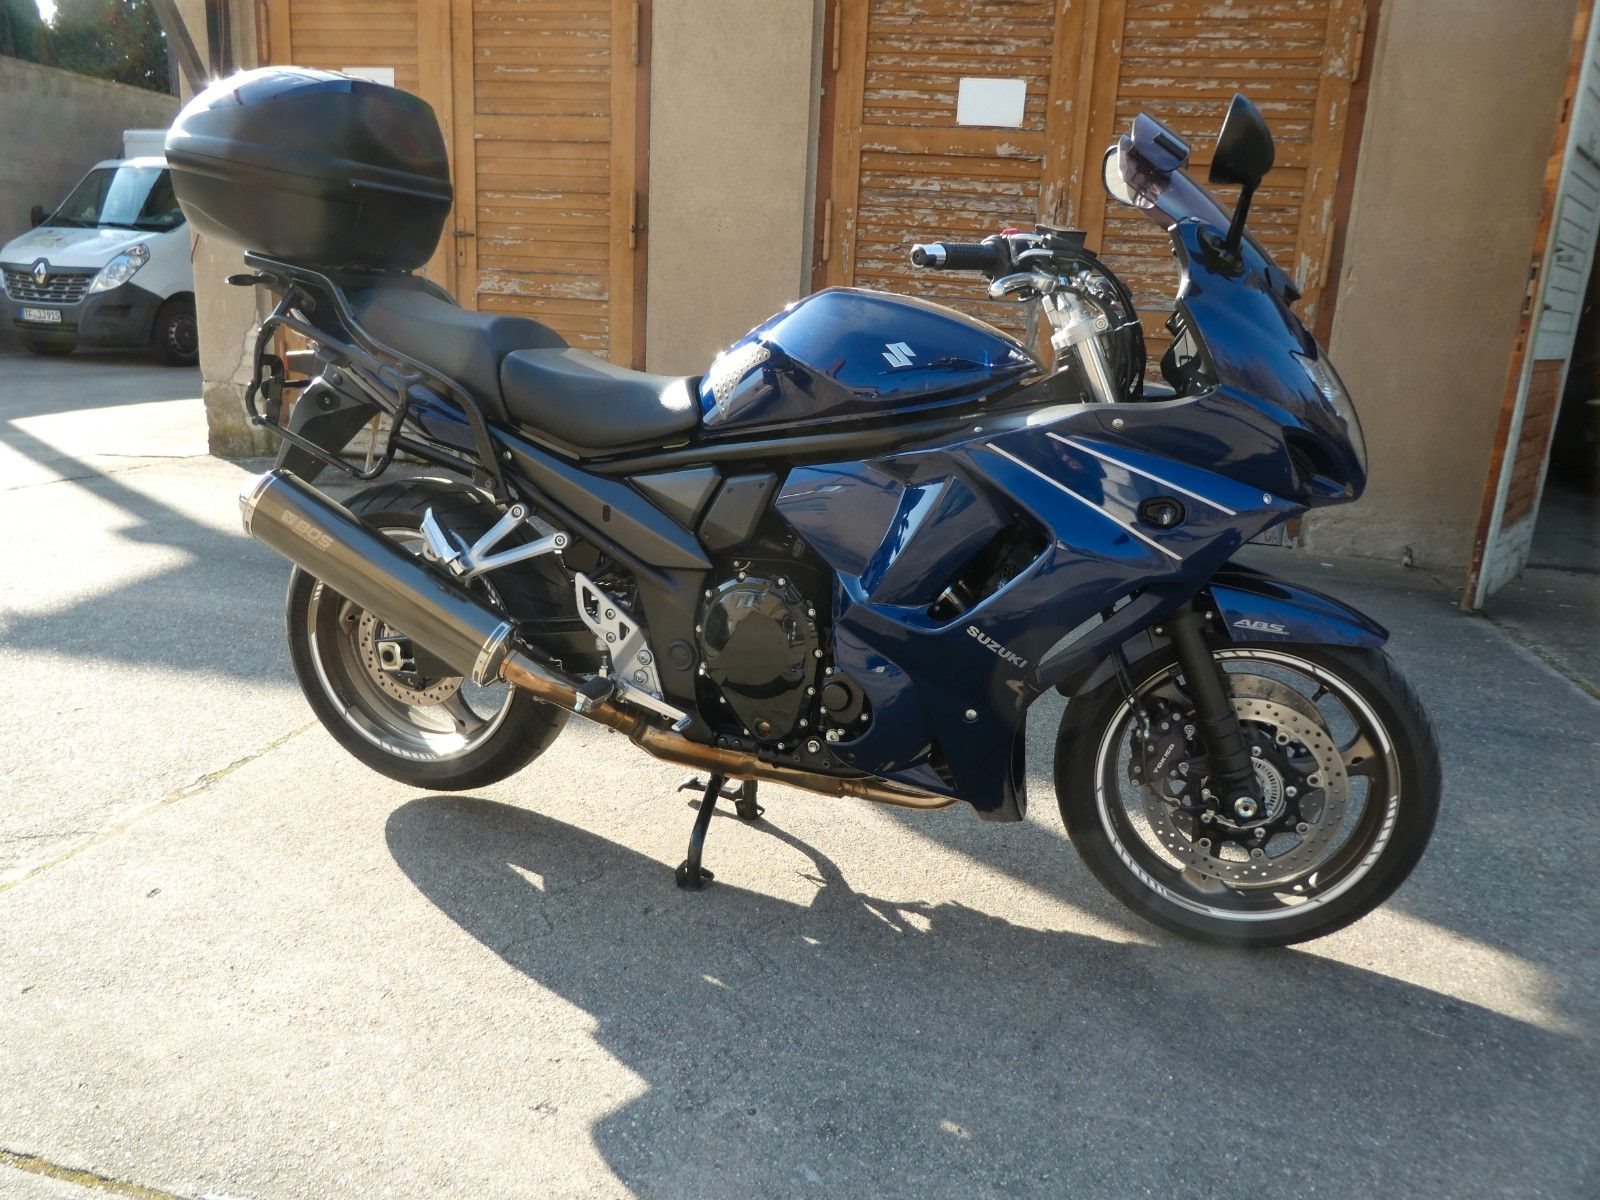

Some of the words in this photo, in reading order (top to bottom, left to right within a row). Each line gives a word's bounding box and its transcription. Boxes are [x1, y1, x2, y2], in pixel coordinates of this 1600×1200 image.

[1233, 619, 1287, 633] ABS
[966, 625, 1028, 668] SUZUKI
[1153, 743, 1175, 773] TOKICO
